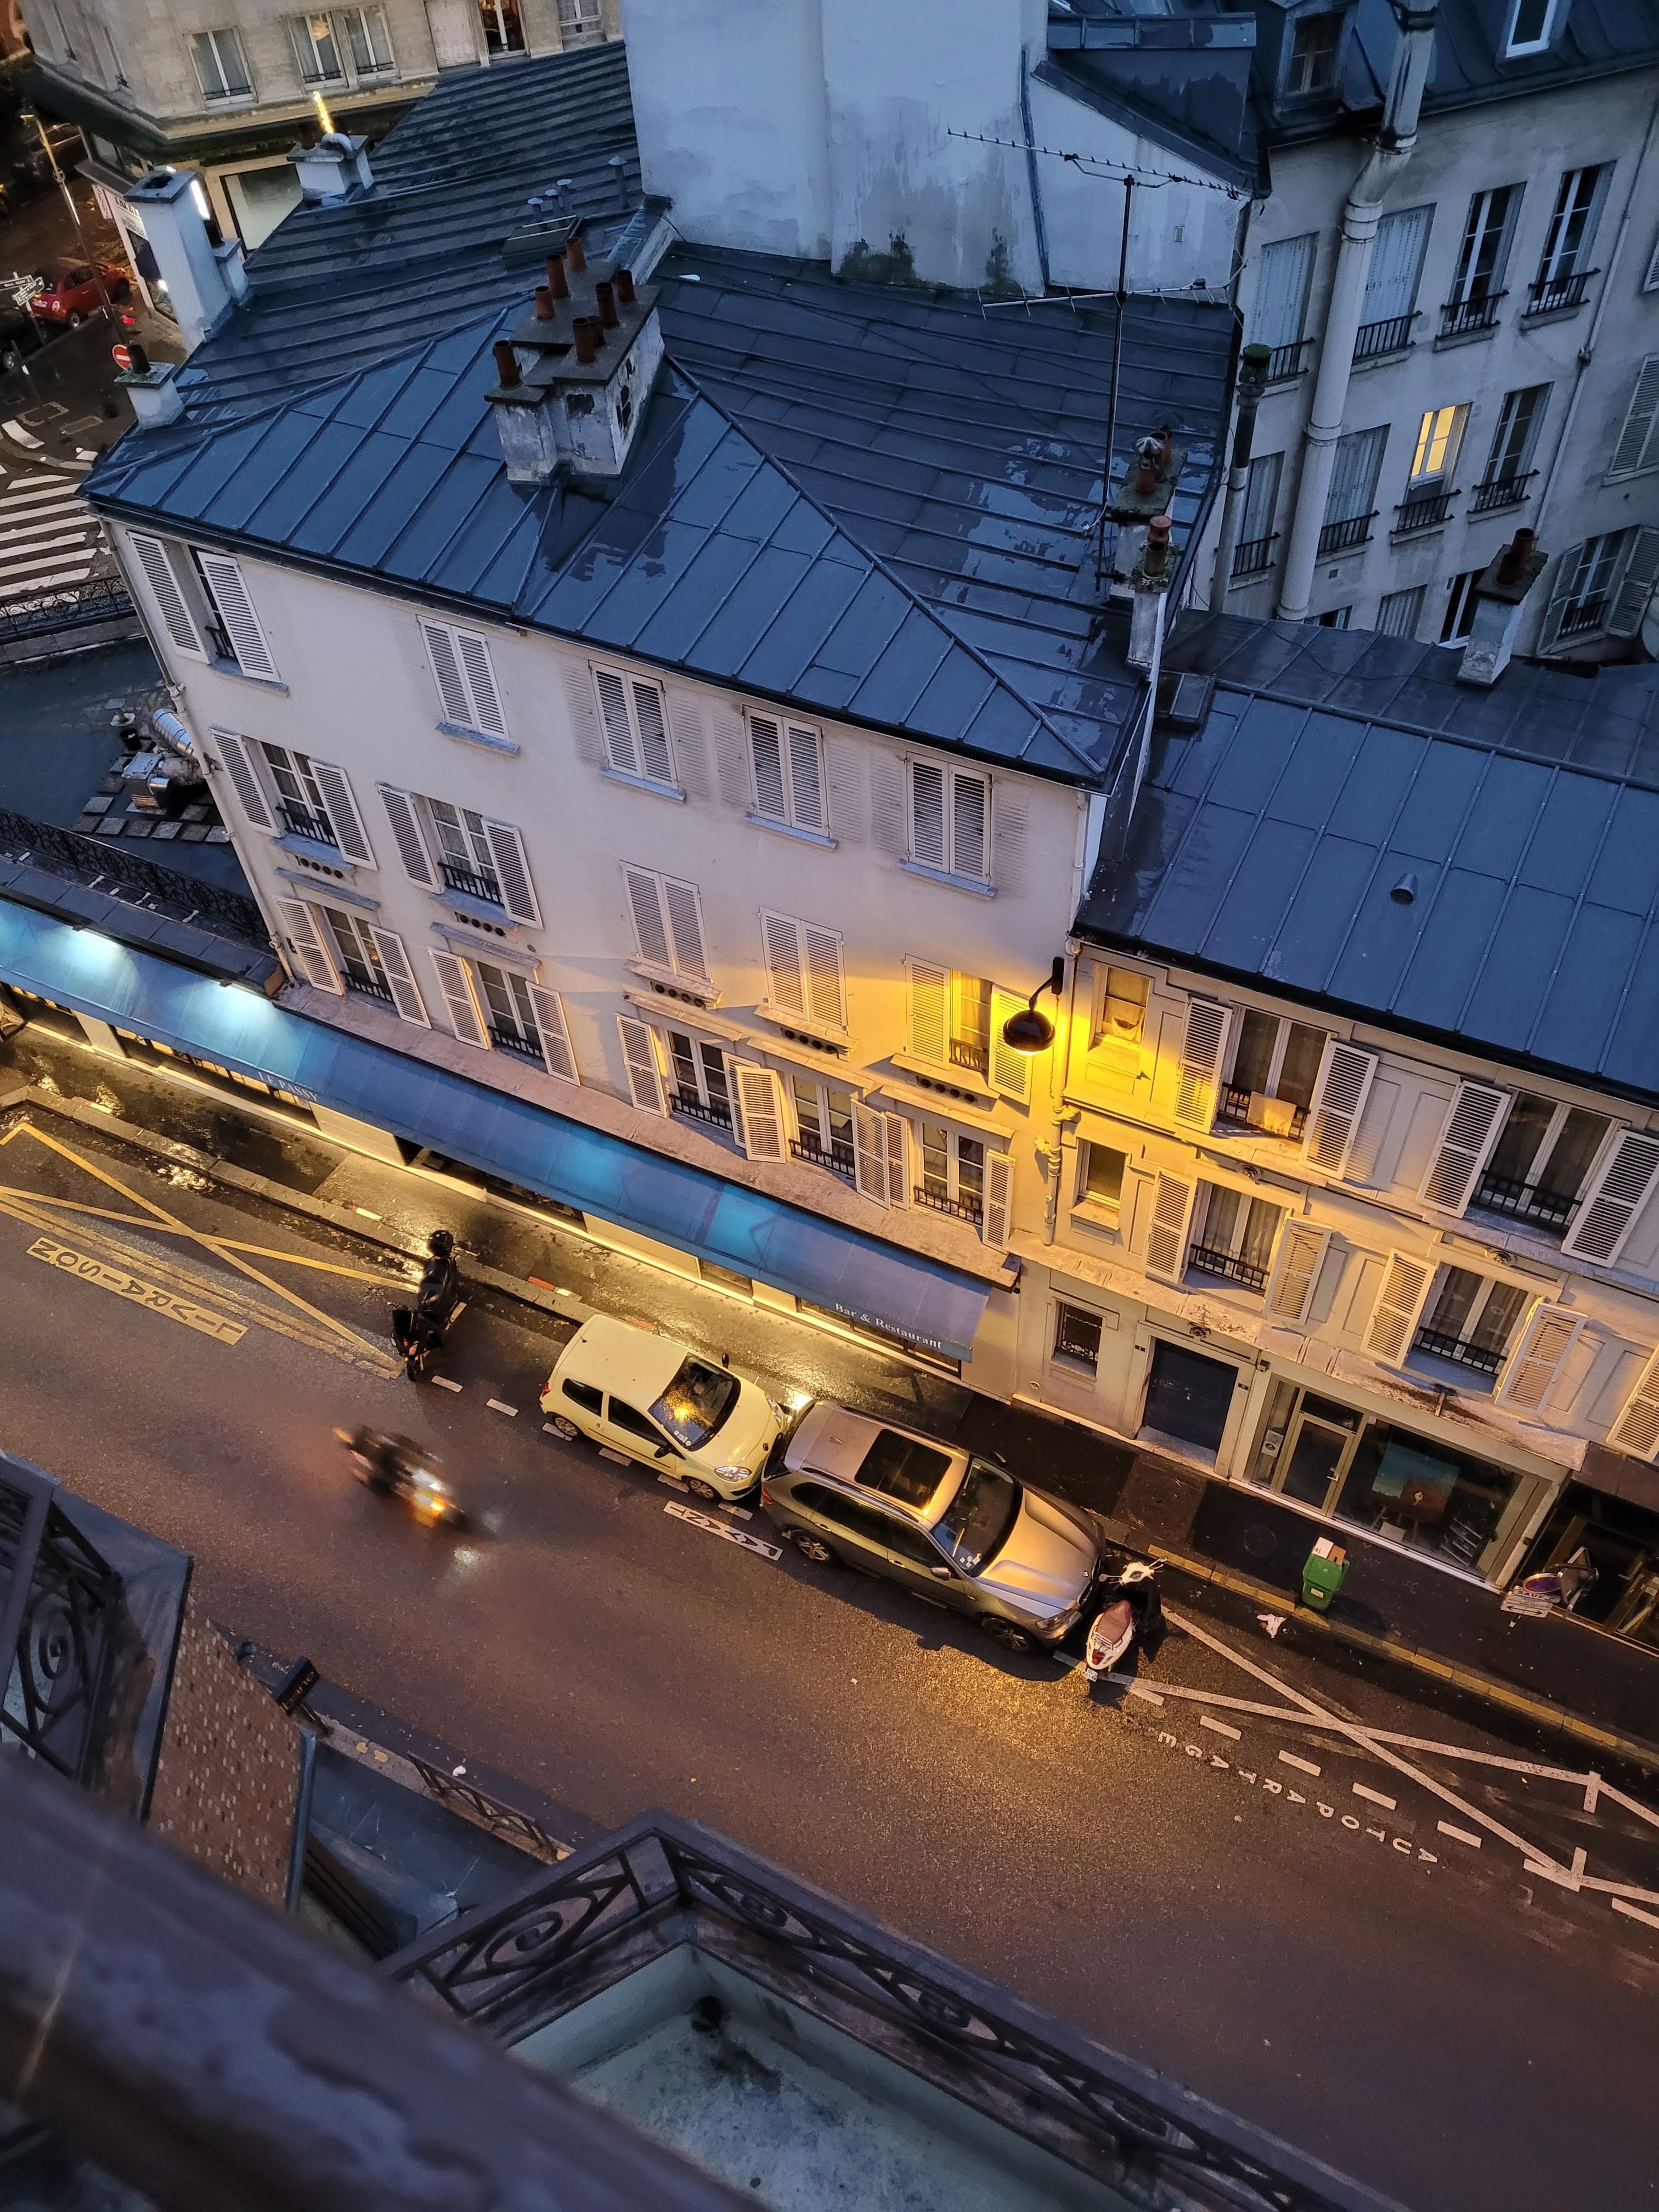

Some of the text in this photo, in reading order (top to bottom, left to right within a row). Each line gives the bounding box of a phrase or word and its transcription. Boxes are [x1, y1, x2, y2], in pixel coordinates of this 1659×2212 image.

[258, 1071, 318, 1101] LE PASSY
[31, 1240, 242, 1334] LIVRAISON
[835, 1302, 943, 1350] Bar & Restaurant
[669, 1506, 780, 1556] PAYANT
[1517, 1590, 1544, 1599] SAUF
[1158, 1731, 1438, 1863] AUTOPARTAGE
